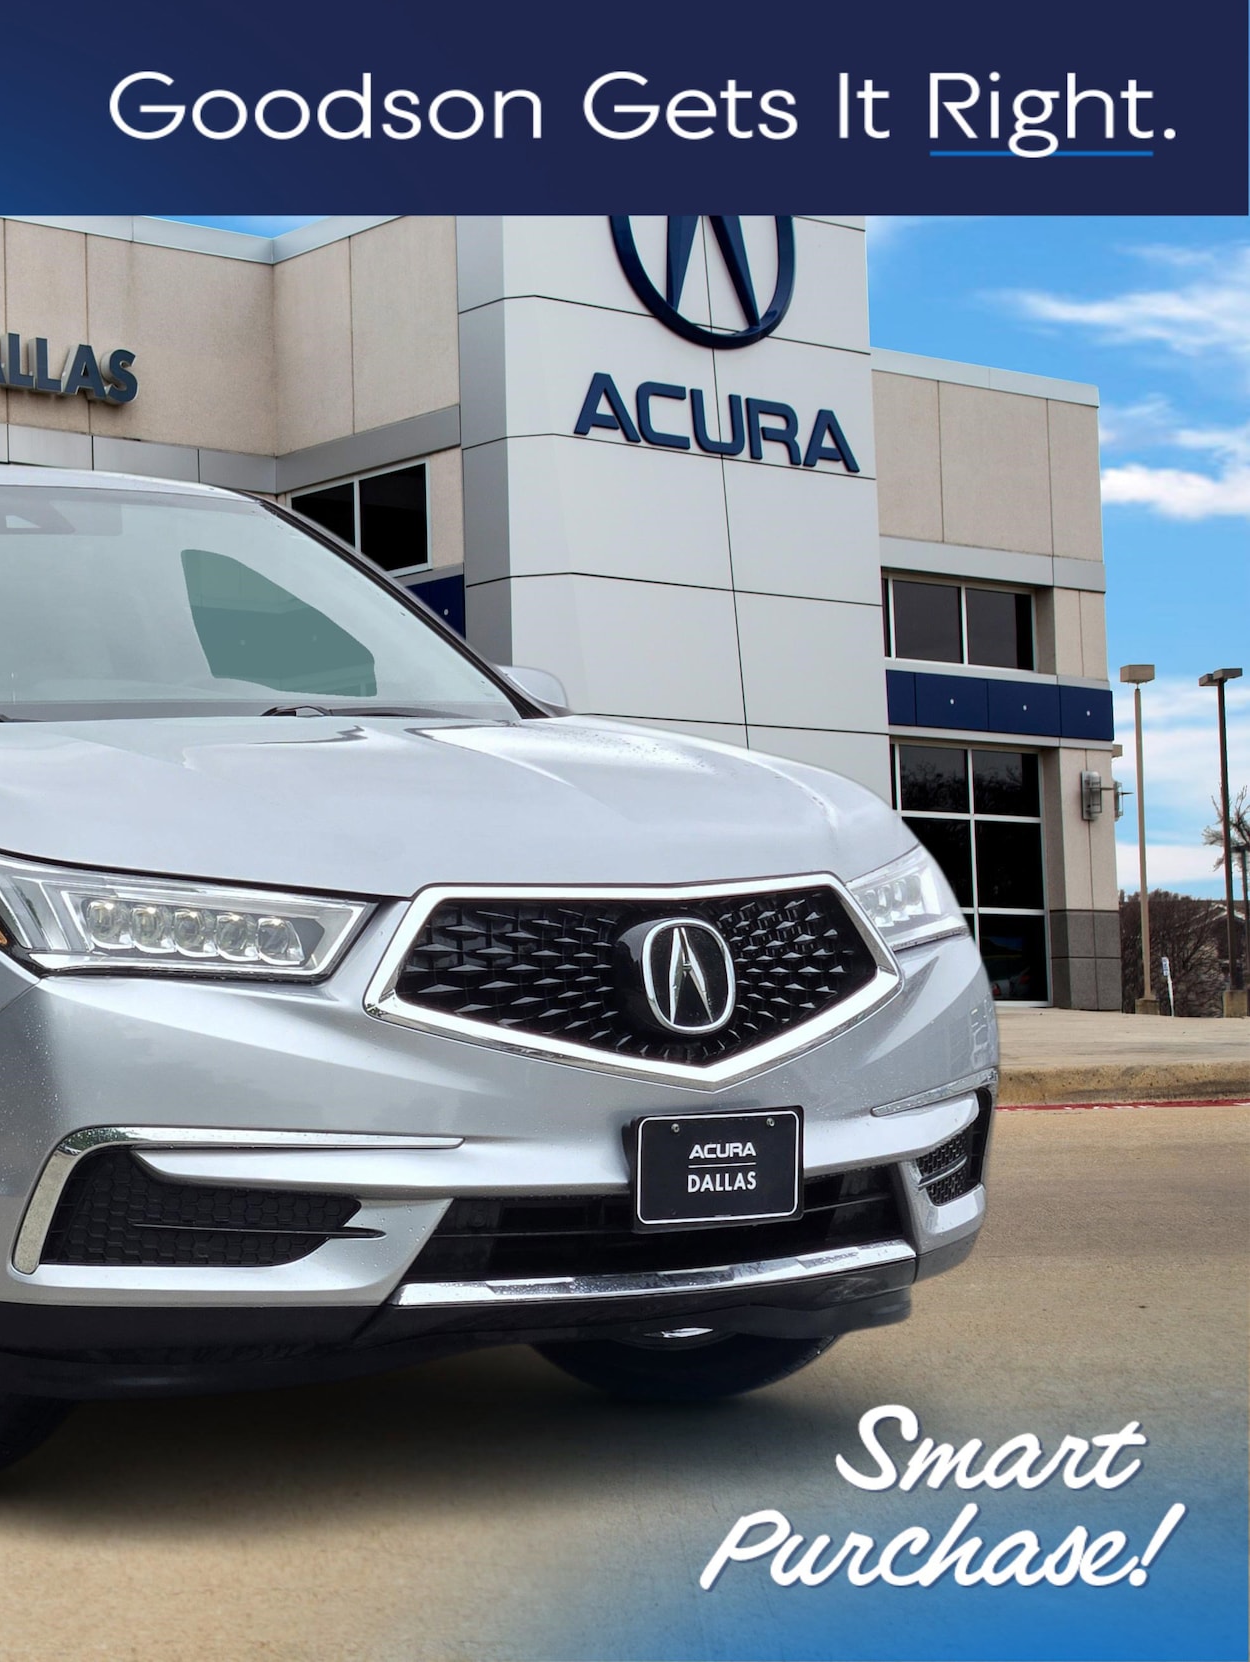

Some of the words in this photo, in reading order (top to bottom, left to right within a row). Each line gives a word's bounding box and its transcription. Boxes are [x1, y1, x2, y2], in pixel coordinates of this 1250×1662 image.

[573, 371, 861, 474] ACURA
[688, 1141, 757, 1160] ACURA
[687, 1171, 757, 1193] DALLAS
